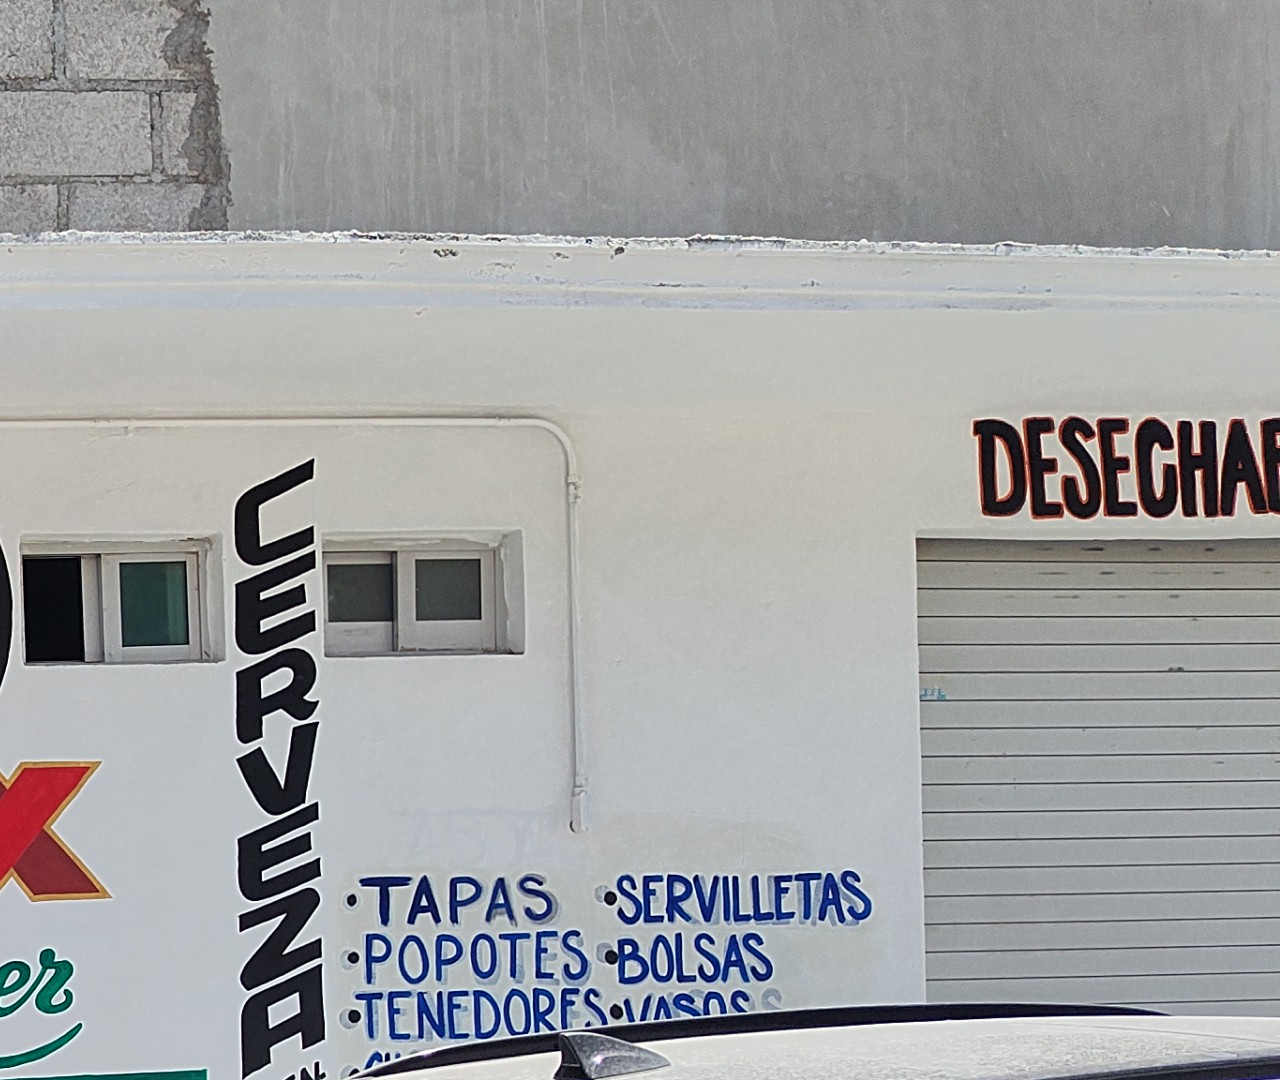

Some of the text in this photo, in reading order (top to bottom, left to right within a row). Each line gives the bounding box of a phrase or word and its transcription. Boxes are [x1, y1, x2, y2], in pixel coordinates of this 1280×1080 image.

[234, 457, 326, 1080] CERVEZA
[359, 873, 558, 928] TAPAS
[616, 869, 873, 925] SERVILLETAS
[362, 929, 590, 986] POPOTES
[617, 931, 775, 985] BOLSAS
[356, 988, 609, 1041] TENEDORES
